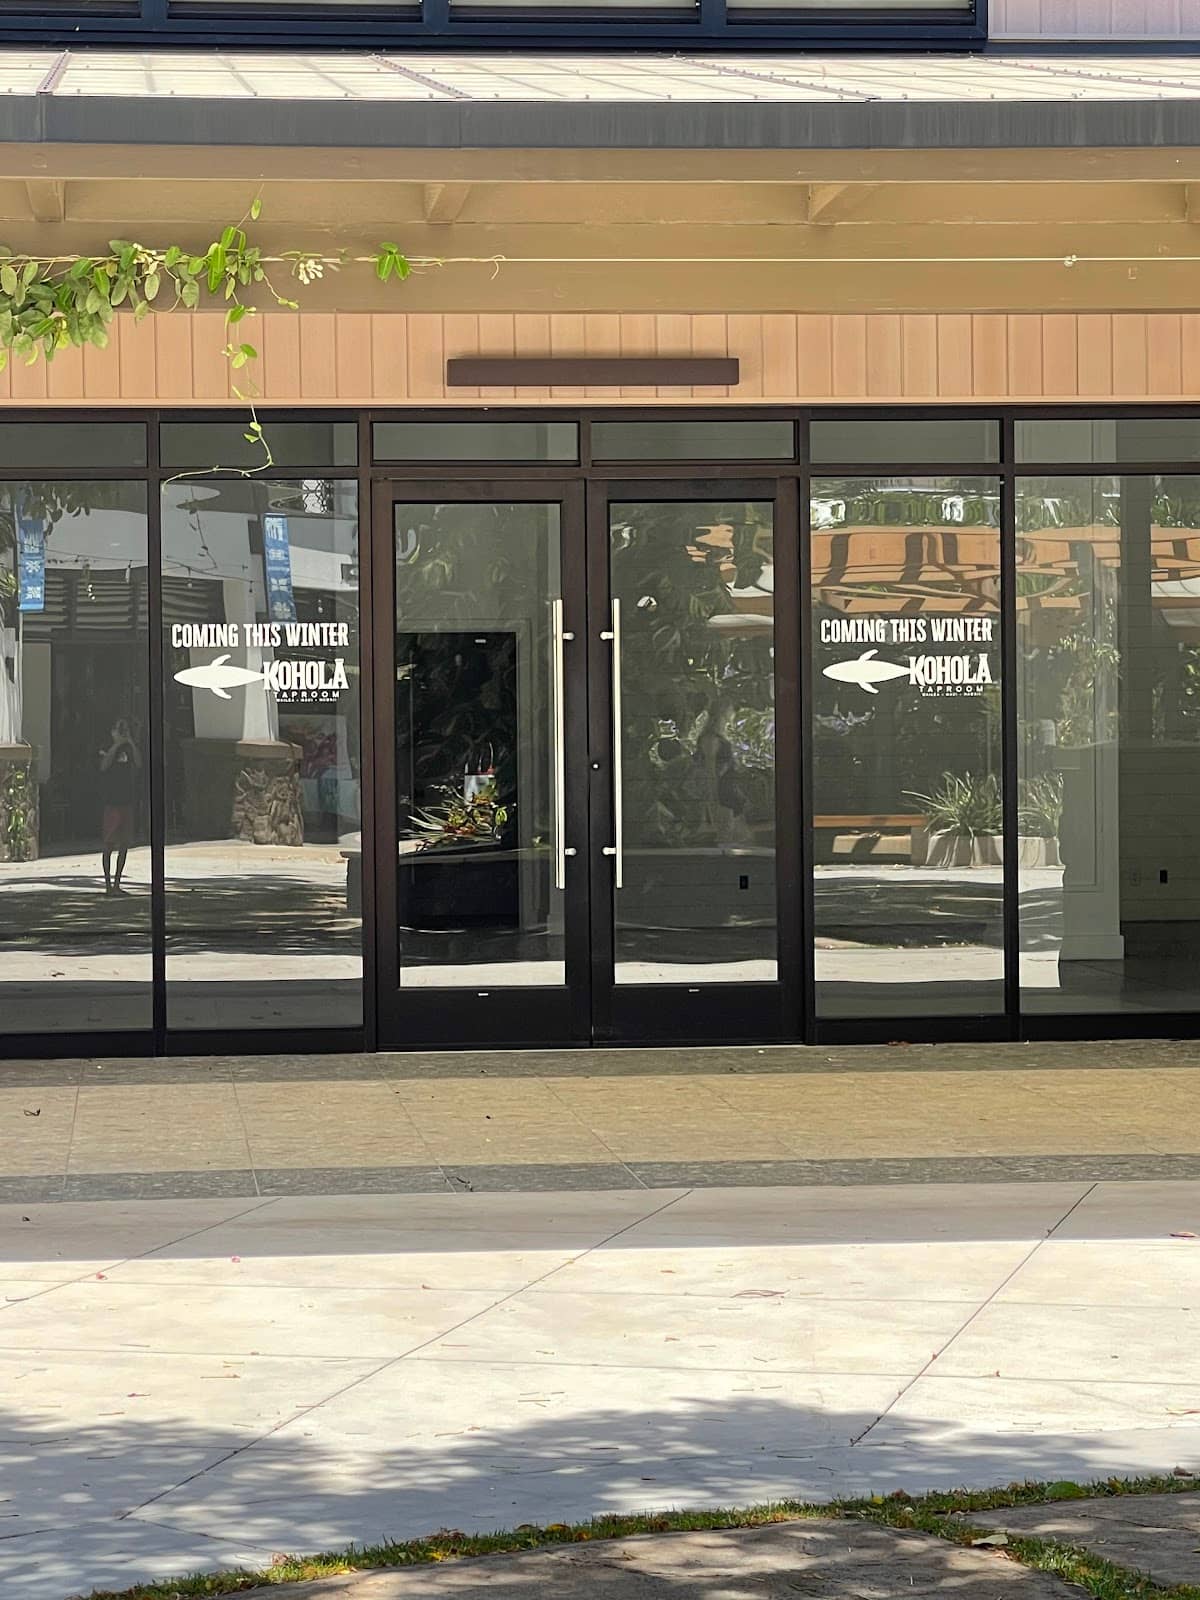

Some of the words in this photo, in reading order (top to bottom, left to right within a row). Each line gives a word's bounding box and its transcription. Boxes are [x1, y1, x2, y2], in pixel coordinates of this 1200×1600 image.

[171, 623, 239, 648] COMING
[243, 623, 281, 648] THIS
[285, 622, 349, 647] WINTER
[820, 618, 886, 643] COMING
[890, 618, 927, 642] THIS
[930, 618, 993, 642] WINTER
